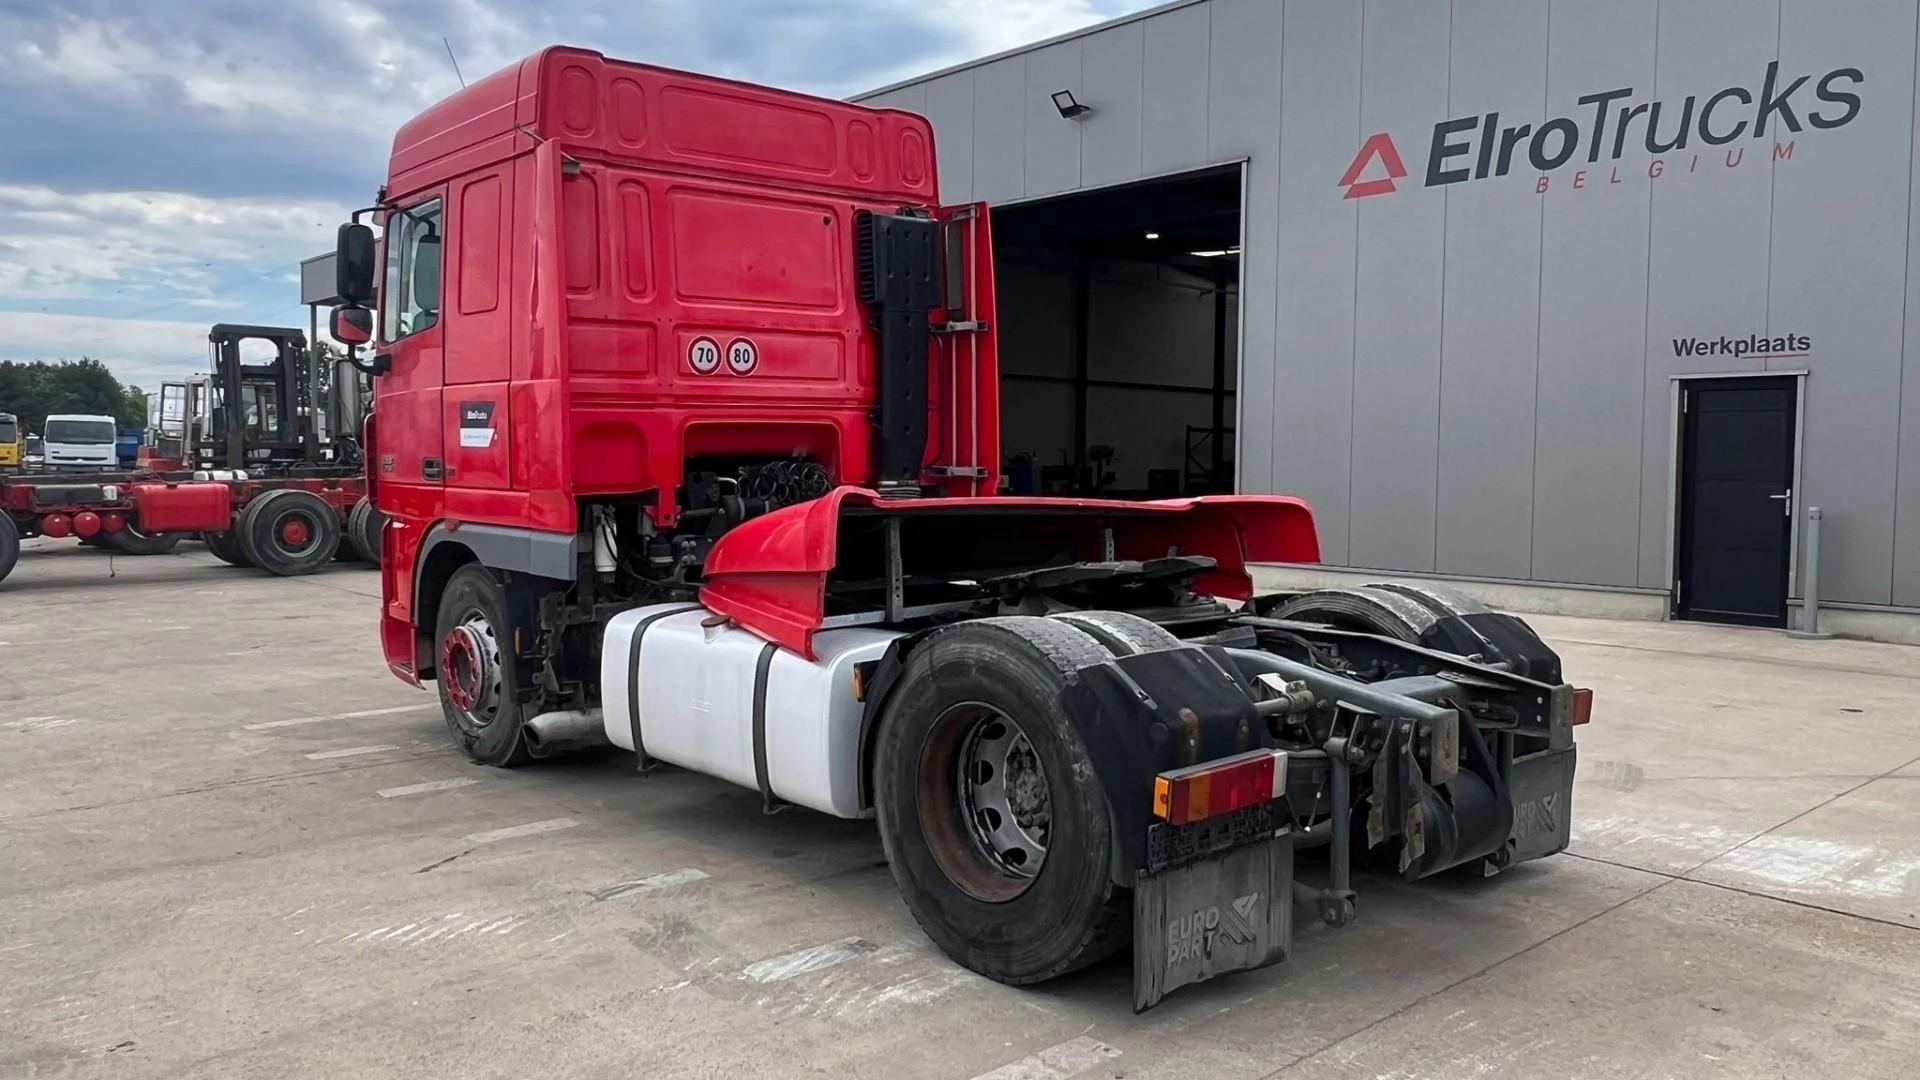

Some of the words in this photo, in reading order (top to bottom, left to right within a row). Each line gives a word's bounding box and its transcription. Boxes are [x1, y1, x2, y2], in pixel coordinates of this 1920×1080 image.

[1425, 61, 1864, 187] ElroTrucks
[1536, 141, 1794, 194] BELGIUM
[698, 347, 714, 363] 70
[734, 348, 750, 363] 80
[1673, 333, 1811, 357] Werkplaats
[1168, 906, 1219, 942] EURO
[1167, 930, 1217, 968] PART
